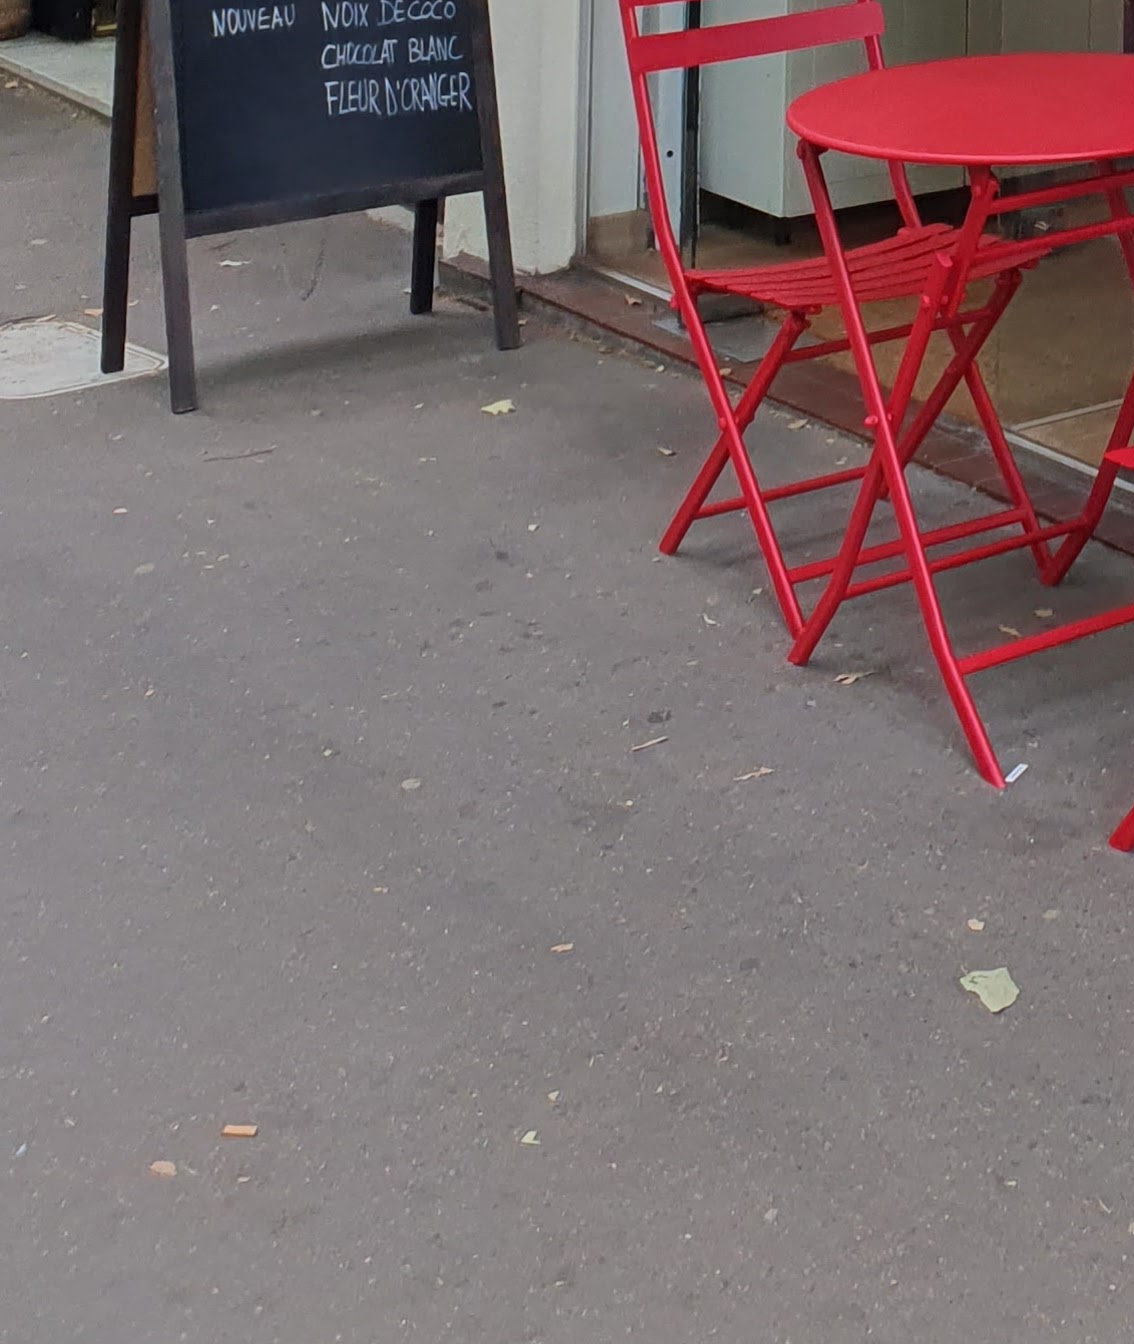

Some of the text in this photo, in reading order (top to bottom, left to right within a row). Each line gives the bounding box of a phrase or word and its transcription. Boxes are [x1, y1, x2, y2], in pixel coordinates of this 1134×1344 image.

[211, 3, 296, 38] NOUVEAU
[320, 0, 369, 32] NOIX
[320, 35, 464, 70] CHOCOLAT BLANC
[324, 71, 474, 117] FLEUR D'ORANGER
